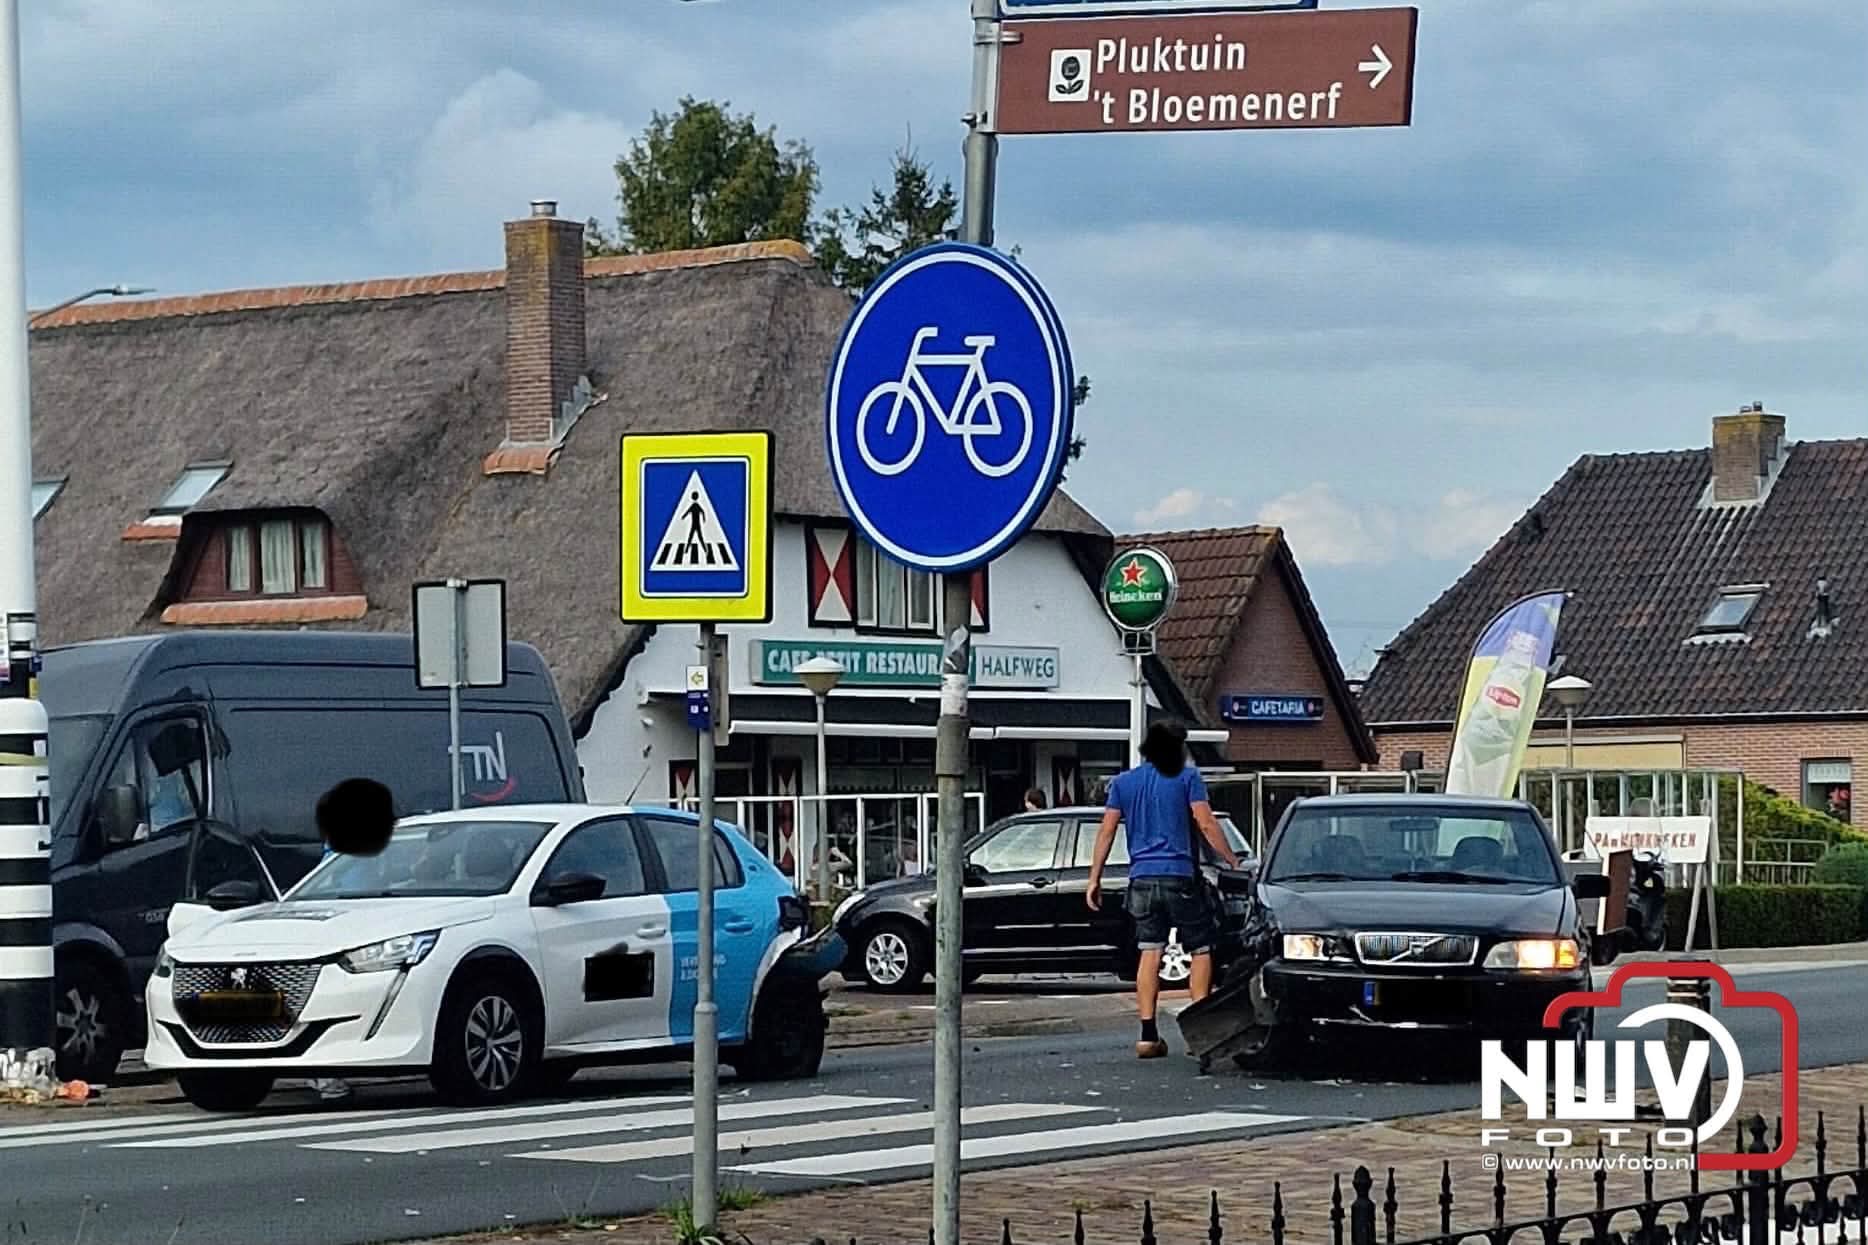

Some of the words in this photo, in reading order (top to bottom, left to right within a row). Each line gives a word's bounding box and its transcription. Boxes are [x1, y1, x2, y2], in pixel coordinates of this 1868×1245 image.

[1096, 34, 1246, 74] Pluktuin
[1094, 90, 1115, 124] 't
[1128, 82, 1342, 124] Bloemenerf
[815, 650, 860, 673] TIT
[866, 651, 973, 675] RESTAUR
[981, 655, 1055, 678] HALFWEG
